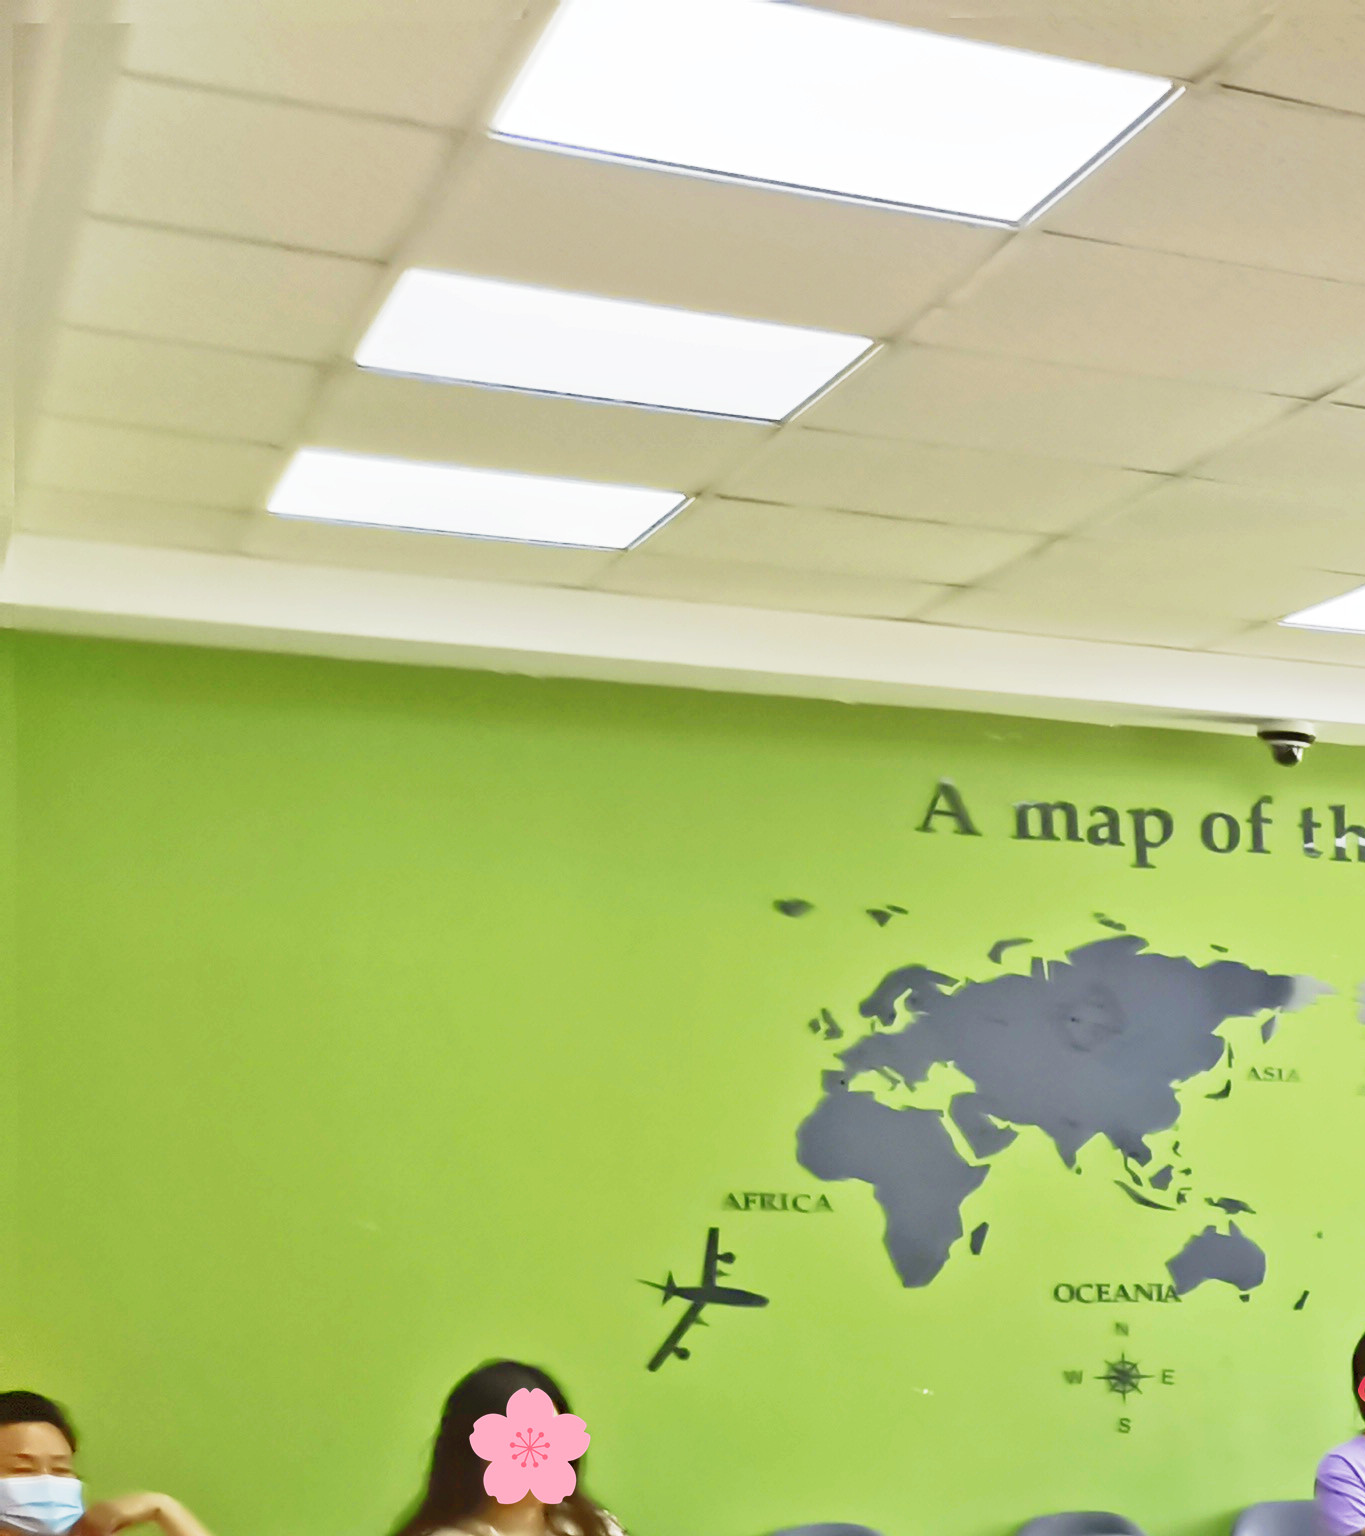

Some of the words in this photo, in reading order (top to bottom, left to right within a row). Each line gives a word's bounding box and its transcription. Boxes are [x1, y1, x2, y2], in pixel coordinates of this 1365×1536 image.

[915, 776, 982, 836] A
[1010, 800, 1174, 868] map
[1200, 795, 1273, 854] of
[1248, 1066, 1300, 1082] ASIA
[722, 1192, 834, 1213] AFRICA
[1053, 1283, 1182, 1303] OCEANIA
[1115, 1322, 1129, 1336] N
[1063, 1370, 1083, 1384] W
[1162, 1369, 1175, 1385] E
[1118, 1417, 1131, 1433] S
